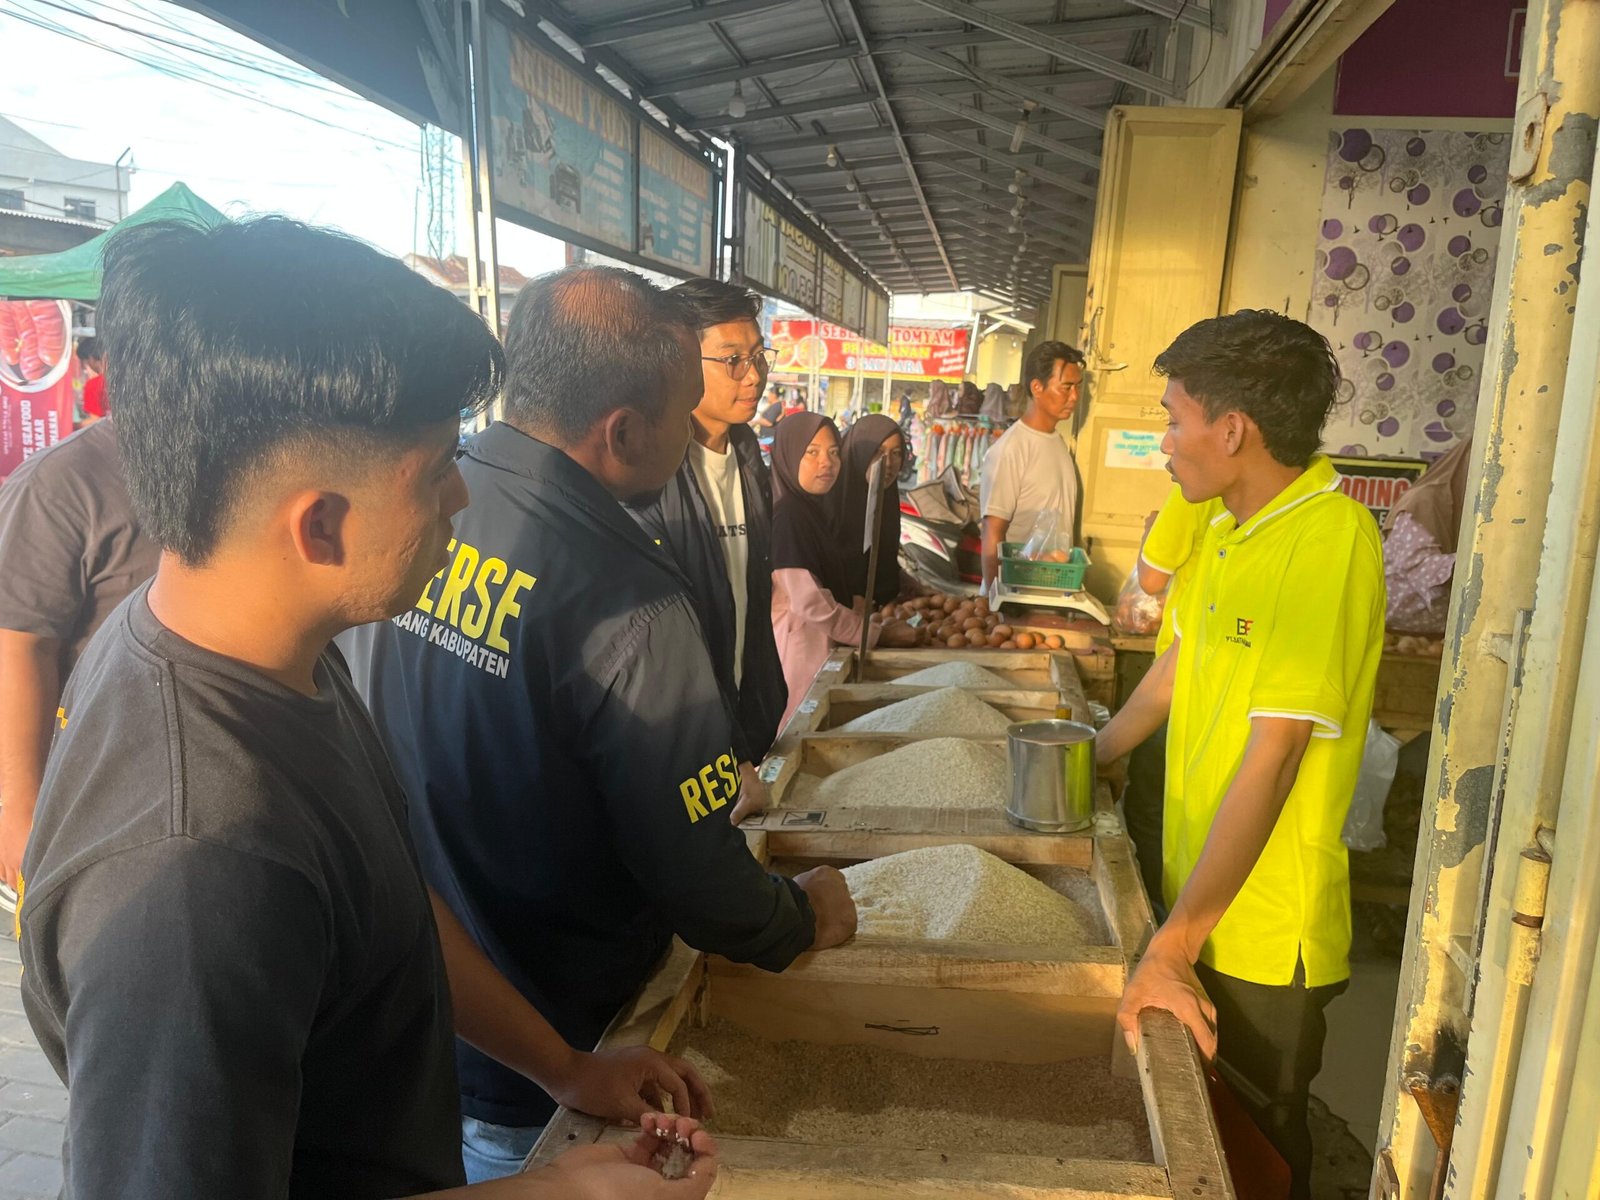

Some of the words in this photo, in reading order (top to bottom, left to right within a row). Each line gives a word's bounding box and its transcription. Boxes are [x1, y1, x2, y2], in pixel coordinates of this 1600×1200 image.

[894, 329, 954, 345] TOMYAM
[20, 400, 32, 445] SEAFOOD
[34, 419, 45, 451] AKAR
[428, 623, 510, 679] KABUPATEN
[679, 747, 742, 824] RES
